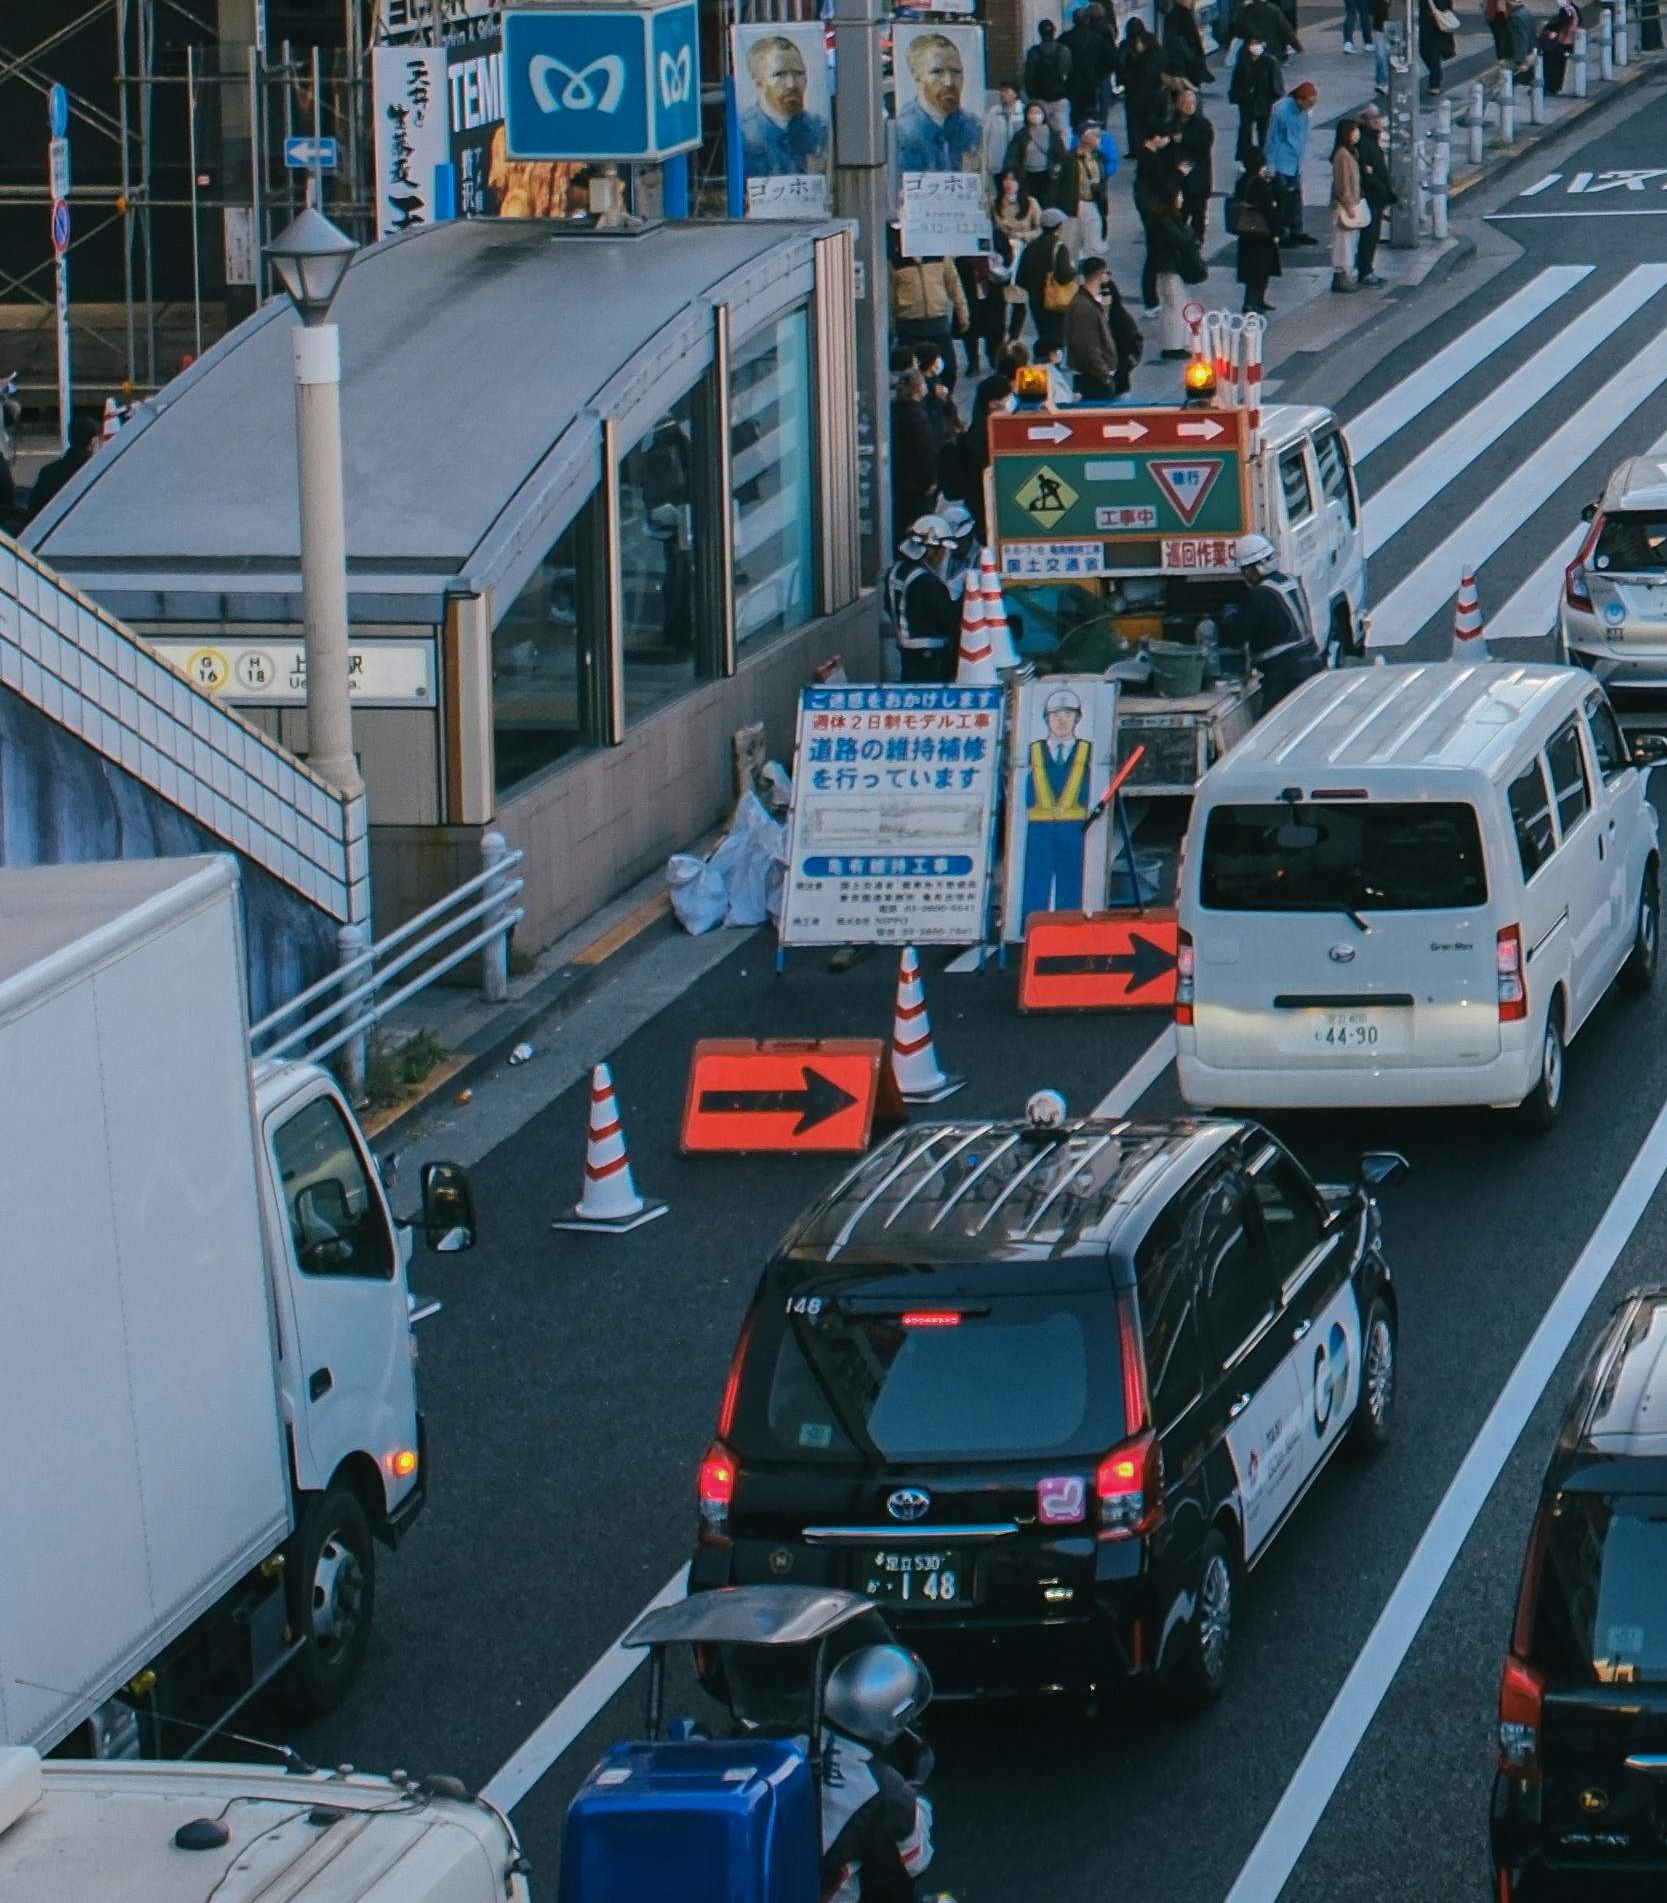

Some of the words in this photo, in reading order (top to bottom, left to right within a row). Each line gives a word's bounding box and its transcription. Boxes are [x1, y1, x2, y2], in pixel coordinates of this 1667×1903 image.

[1102, 510, 1154, 526] 工事中
[201, 657, 212, 668] G
[250, 658, 260, 668] H
[201, 670, 217, 683] 16
[247, 671, 265, 683] 18
[811, 692, 993, 709] ご迷惑をおかけします
[808, 736, 987, 764] 道路の維持補修
[812, 767, 981, 790] を行っています
[1326, 1026, 1378, 1046] 44-90
[785, 1296, 822, 1315] 148
